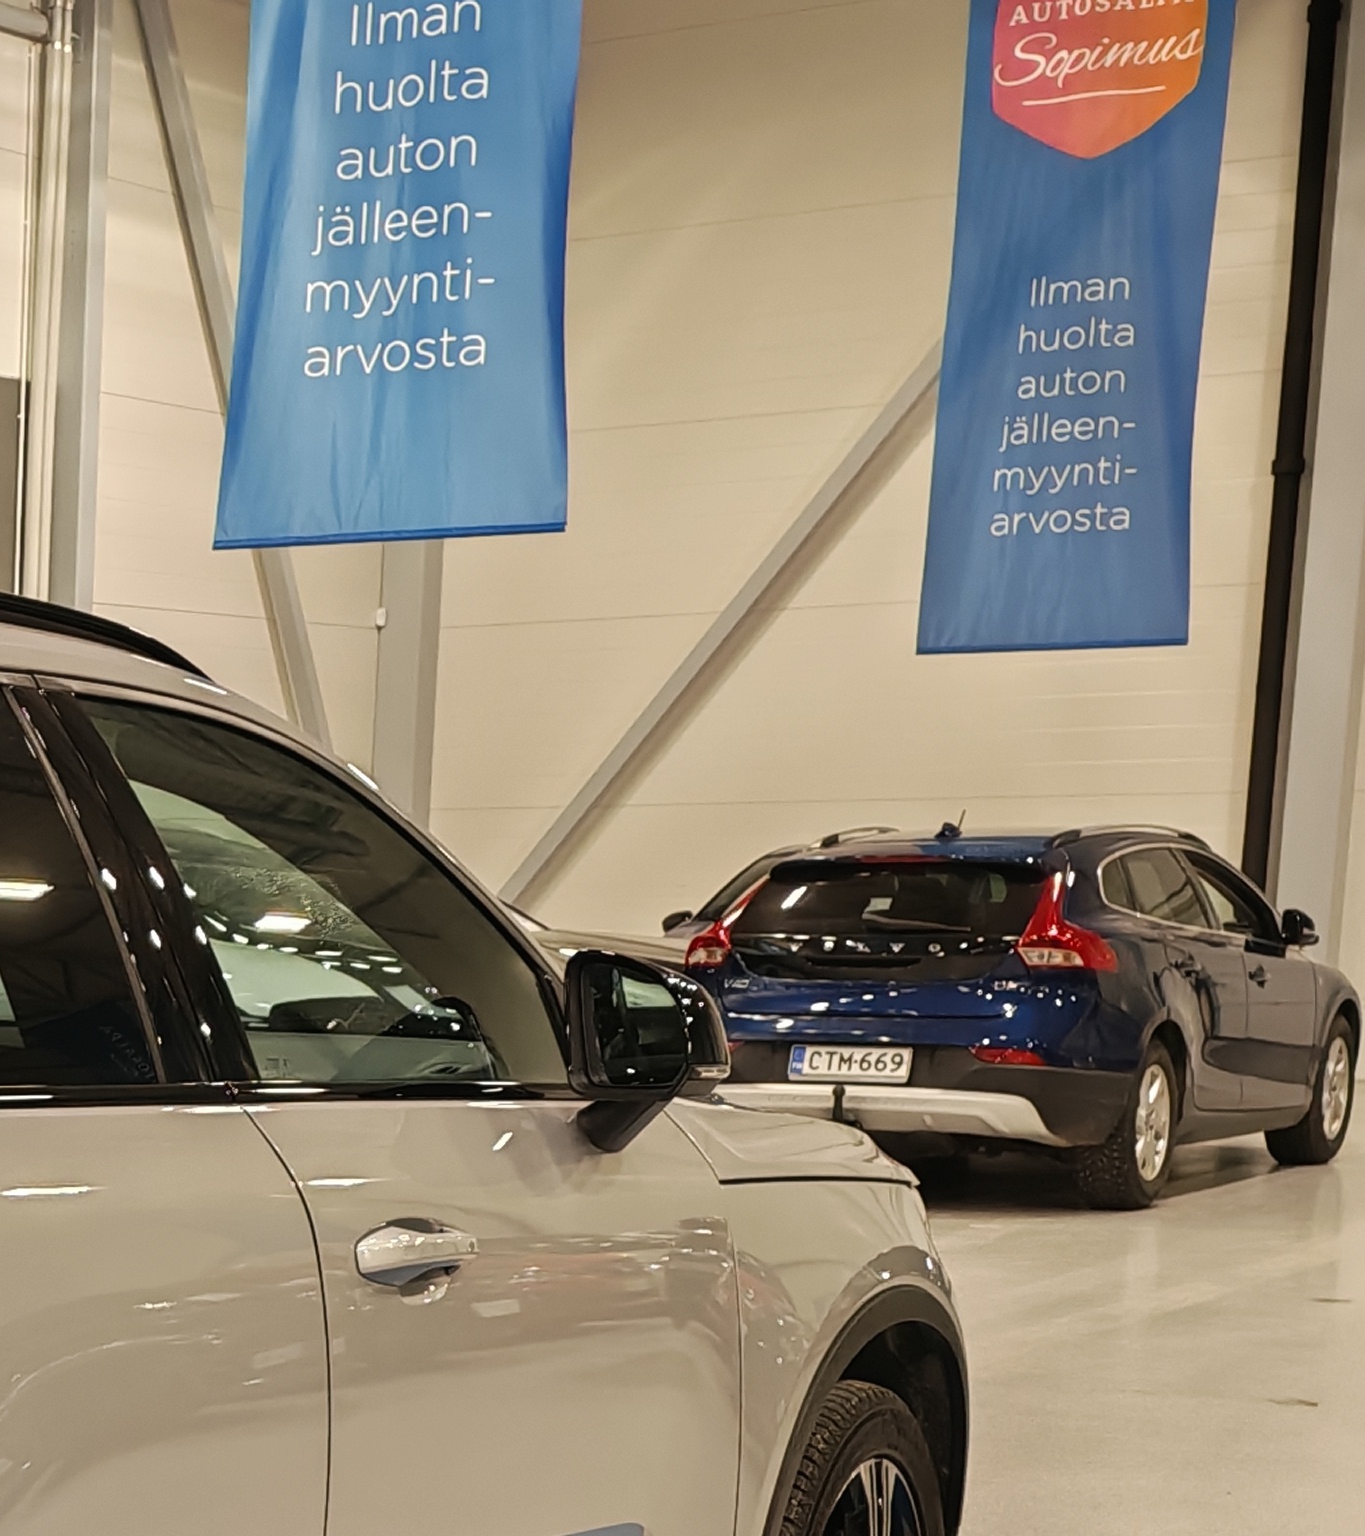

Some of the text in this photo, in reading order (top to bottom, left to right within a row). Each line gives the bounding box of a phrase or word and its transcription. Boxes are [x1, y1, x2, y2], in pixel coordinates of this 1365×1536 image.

[350, 0, 481, 47] Ilman
[1008, 0, 1195, 27] AUTOSA
[993, 27, 1204, 89] Sopimus
[334, 59, 489, 114] huolta
[336, 133, 477, 180] auton
[310, 200, 493, 256] jälleen-
[305, 257, 496, 319] myynti-
[1030, 276, 1130, 307] Ilman
[303, 328, 486, 378] arvosta
[1018, 316, 1135, 355] huolta
[1017, 367, 1125, 400] auton
[998, 412, 1137, 453] jälleen-
[992, 454, 1138, 496] myynti-
[990, 502, 1131, 537] arvosta
